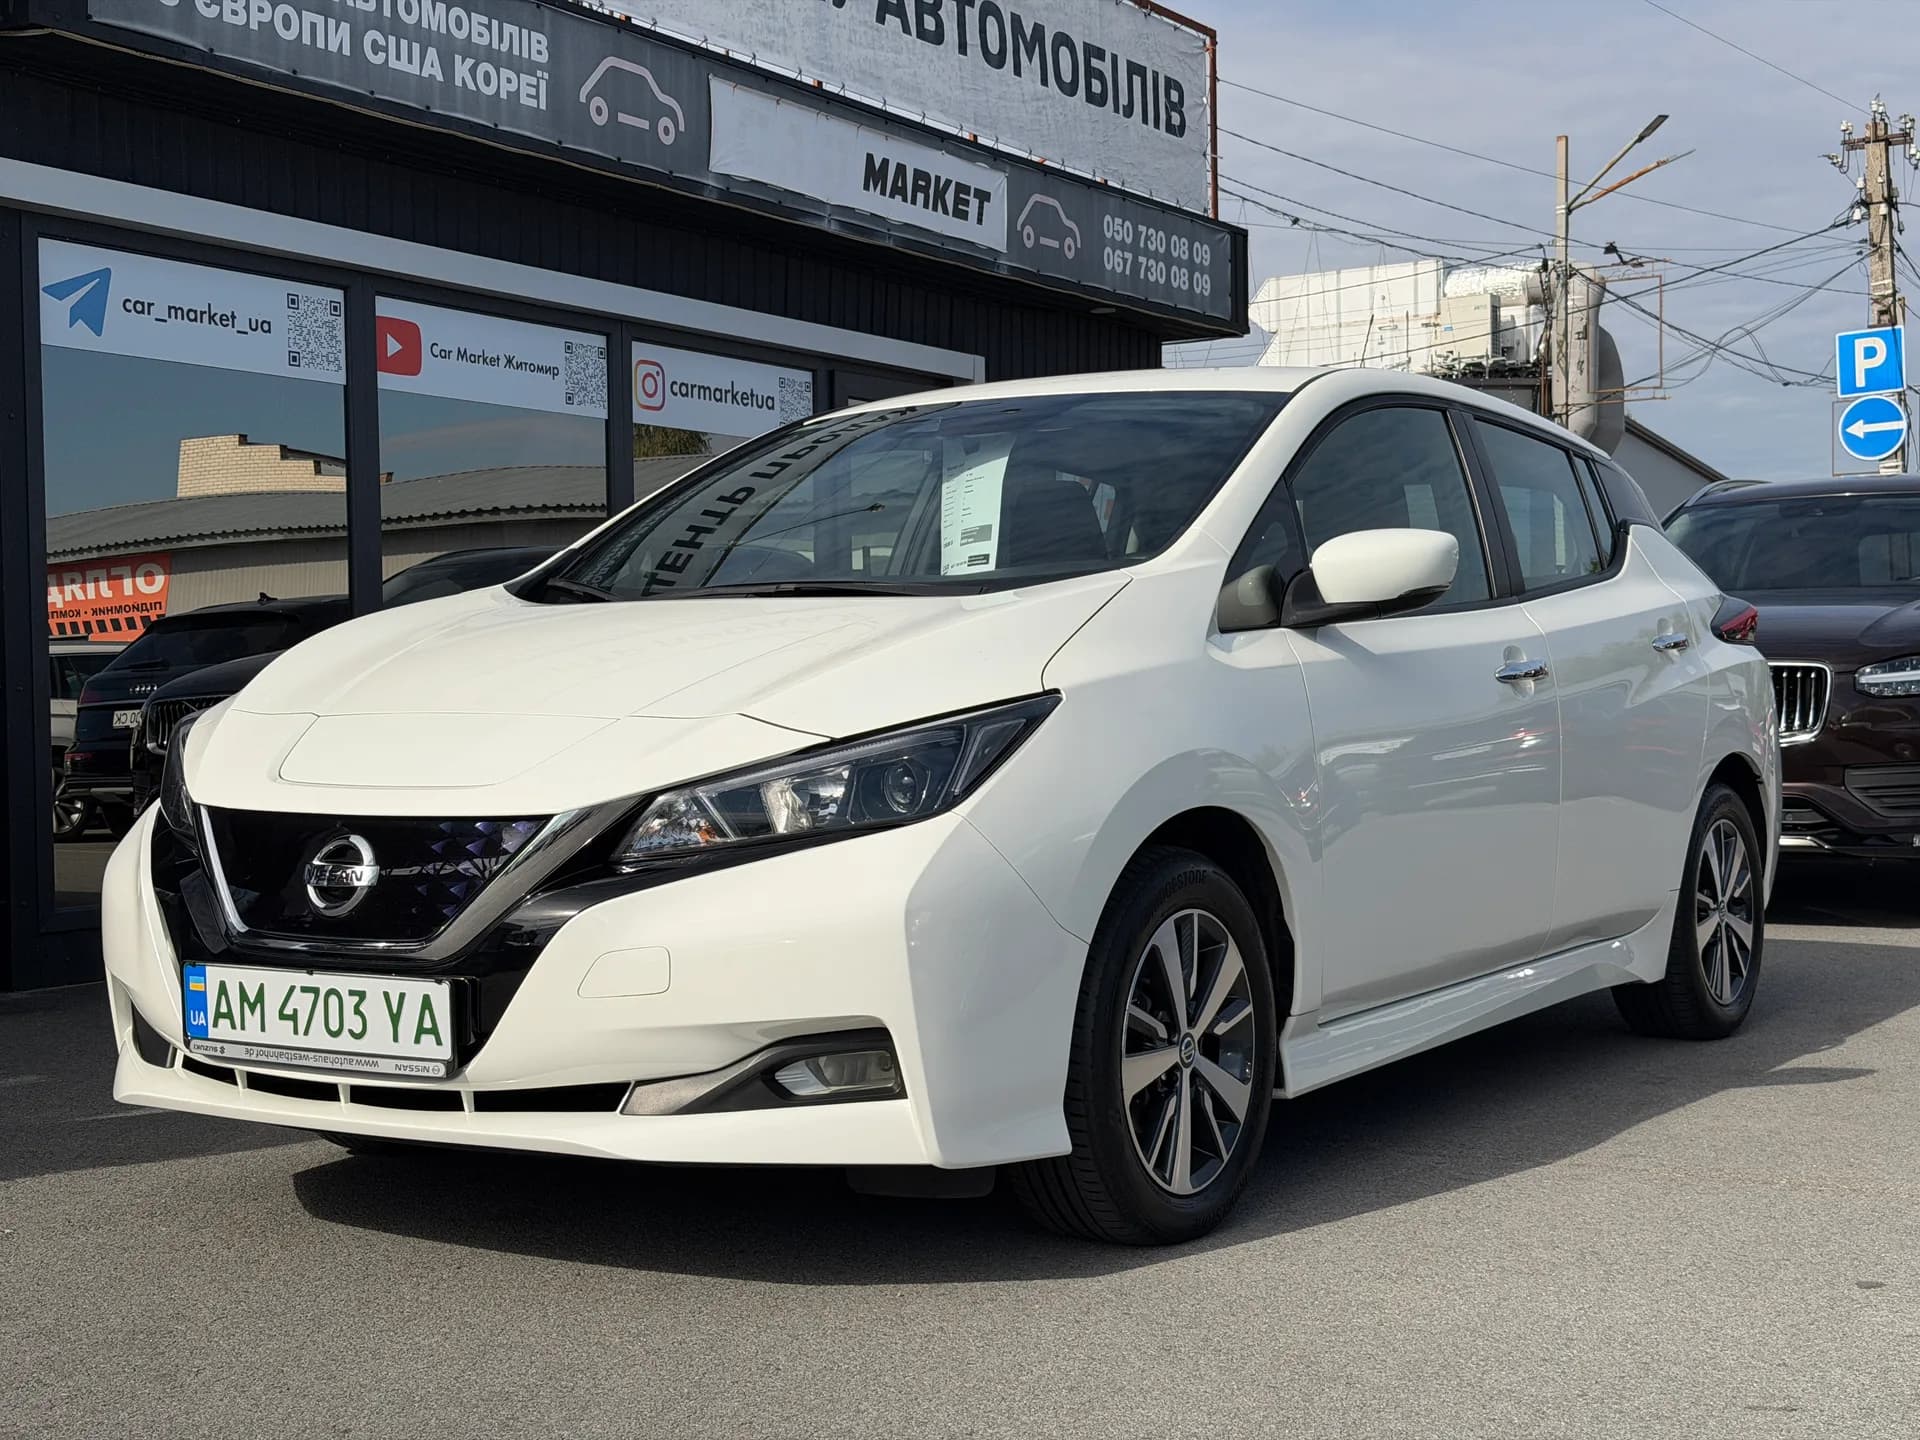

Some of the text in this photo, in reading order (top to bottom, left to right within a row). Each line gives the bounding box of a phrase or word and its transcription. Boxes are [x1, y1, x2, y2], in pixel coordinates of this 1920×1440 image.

[332, 0, 550, 64] ОМОБІЛІВ
[363, 29, 444, 82] США
[454, 53, 549, 110] КОРЕЇ
[862, 152, 992, 226] MARKET
[1103, 214, 1211, 267] 050 730 08 09
[1103, 246, 1211, 297] 067 730 08 09
[122, 296, 272, 335] car_market_ua
[429, 342, 560, 380] Car Market Житомир
[1854, 336, 1887, 388] P
[669, 379, 776, 411] carmarketua
[189, 1009, 208, 1028] UA
[211, 979, 444, 1047] AM 4703 YA
[193, 1043, 219, 1054] SUZUKI
[394, 1063, 431, 1074] NISSAN
